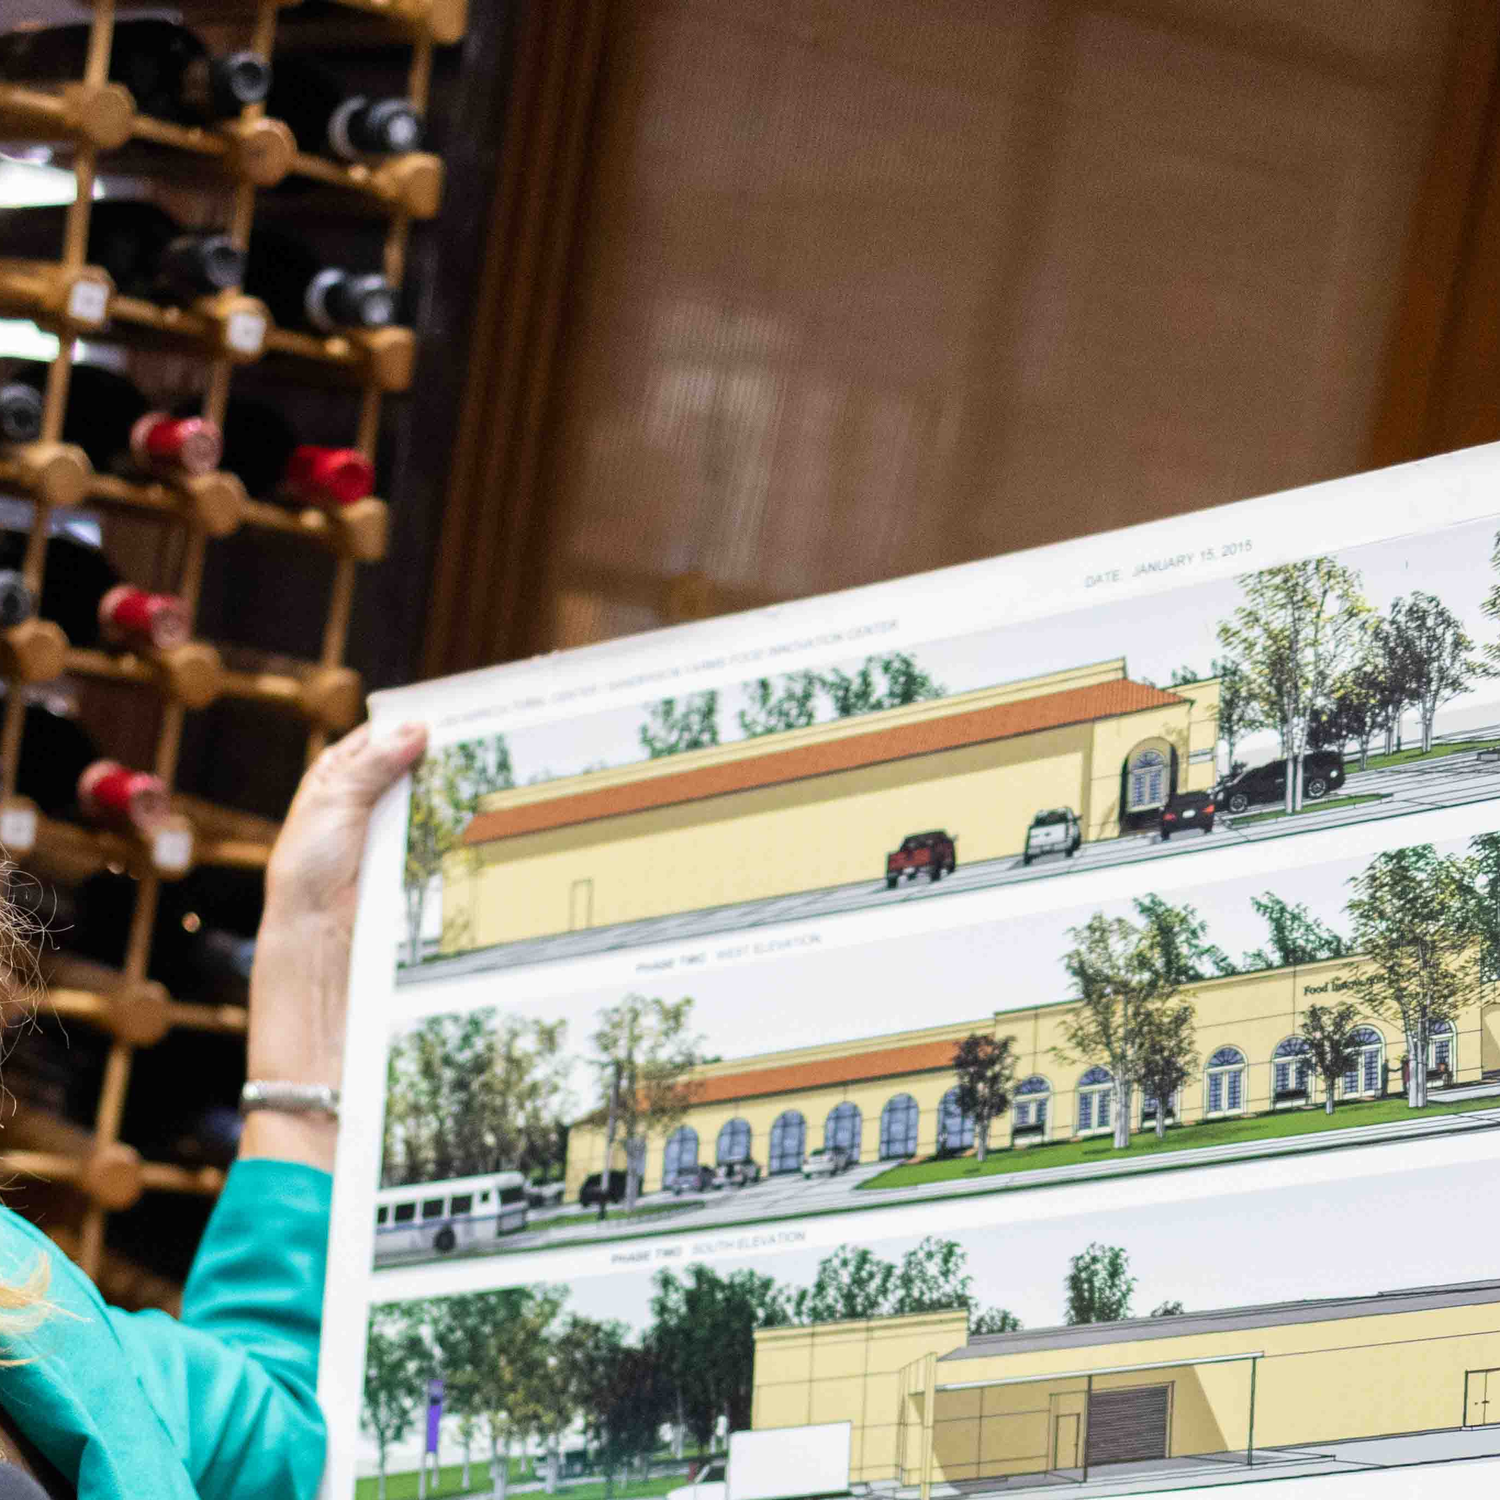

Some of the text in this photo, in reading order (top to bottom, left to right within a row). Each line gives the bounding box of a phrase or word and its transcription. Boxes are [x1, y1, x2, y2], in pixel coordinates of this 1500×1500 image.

[1131, 549, 1196, 577] JANUARY
[1221, 538, 1253, 558] 2015
[1304, 982, 1328, 995] Food
